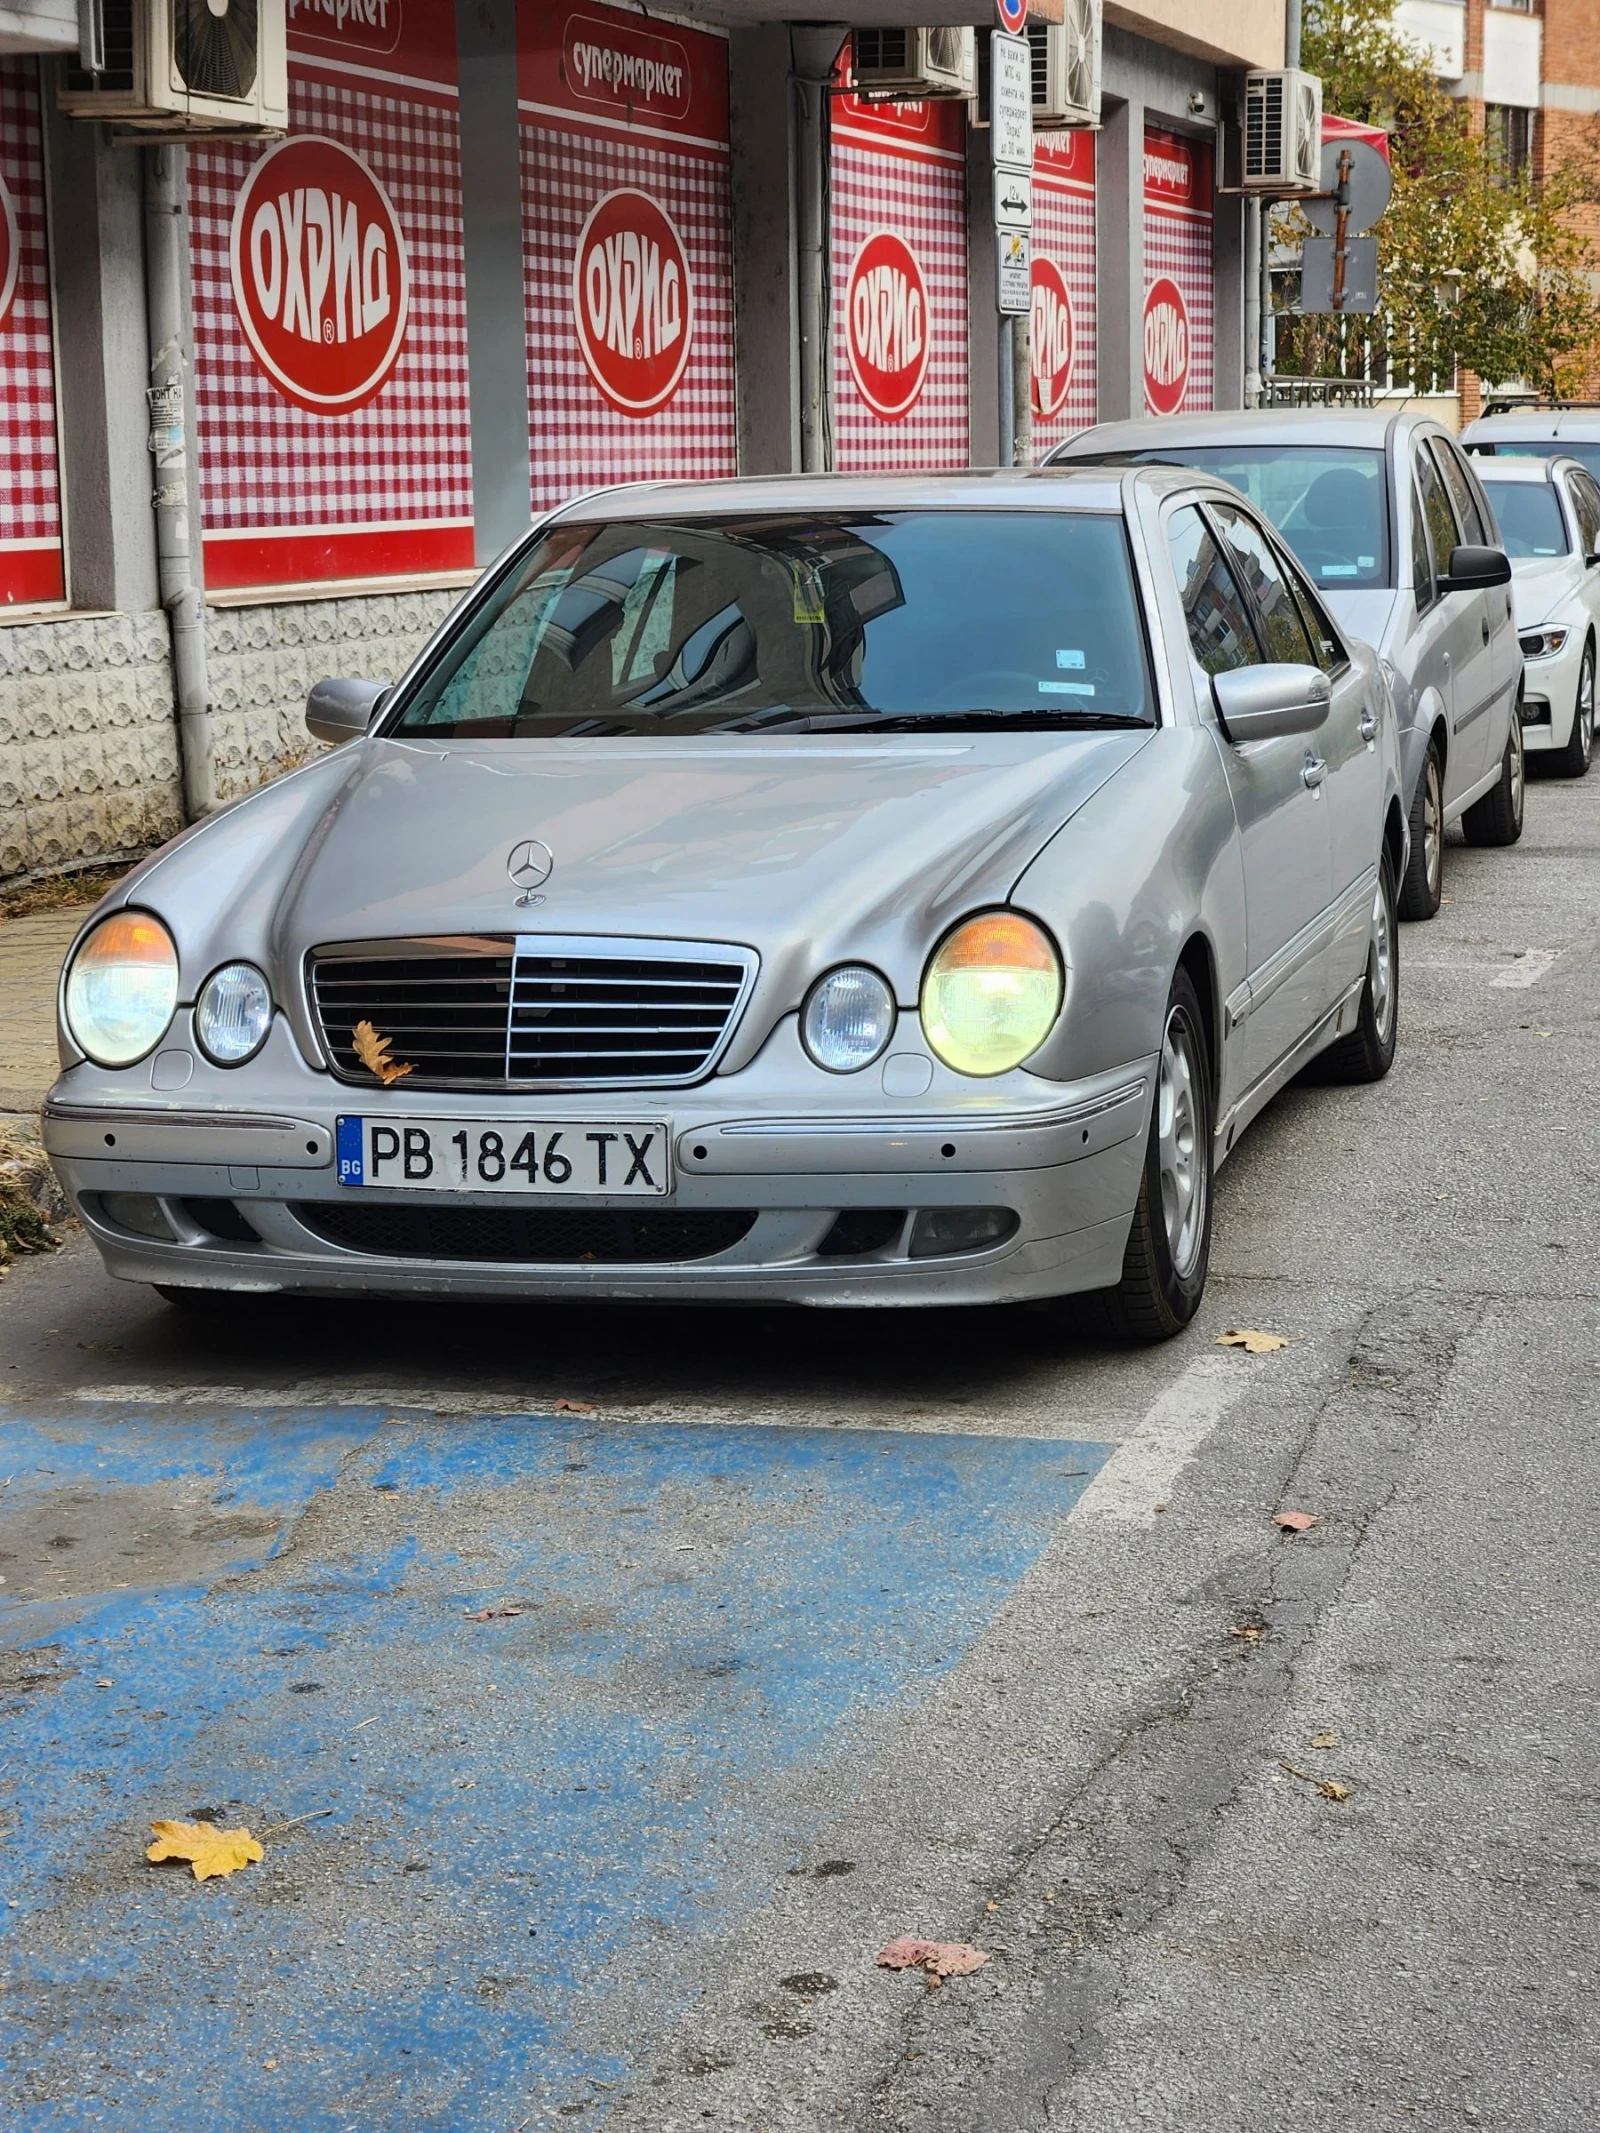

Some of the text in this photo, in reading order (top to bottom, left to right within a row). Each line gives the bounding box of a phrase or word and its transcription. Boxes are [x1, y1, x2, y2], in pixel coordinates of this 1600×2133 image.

[572, 41, 683, 102] супермаркет
[999, 104, 1027, 121] супермаркет
[250, 187, 392, 344] ОХРИД
[585, 230, 682, 360] ОХРИД
[853, 265, 922, 373] ОХРИД
[1144, 302, 1187, 386] ОХРИД
[341, 1159, 361, 1176] BG
[452, 1129, 572, 1184] 1846
